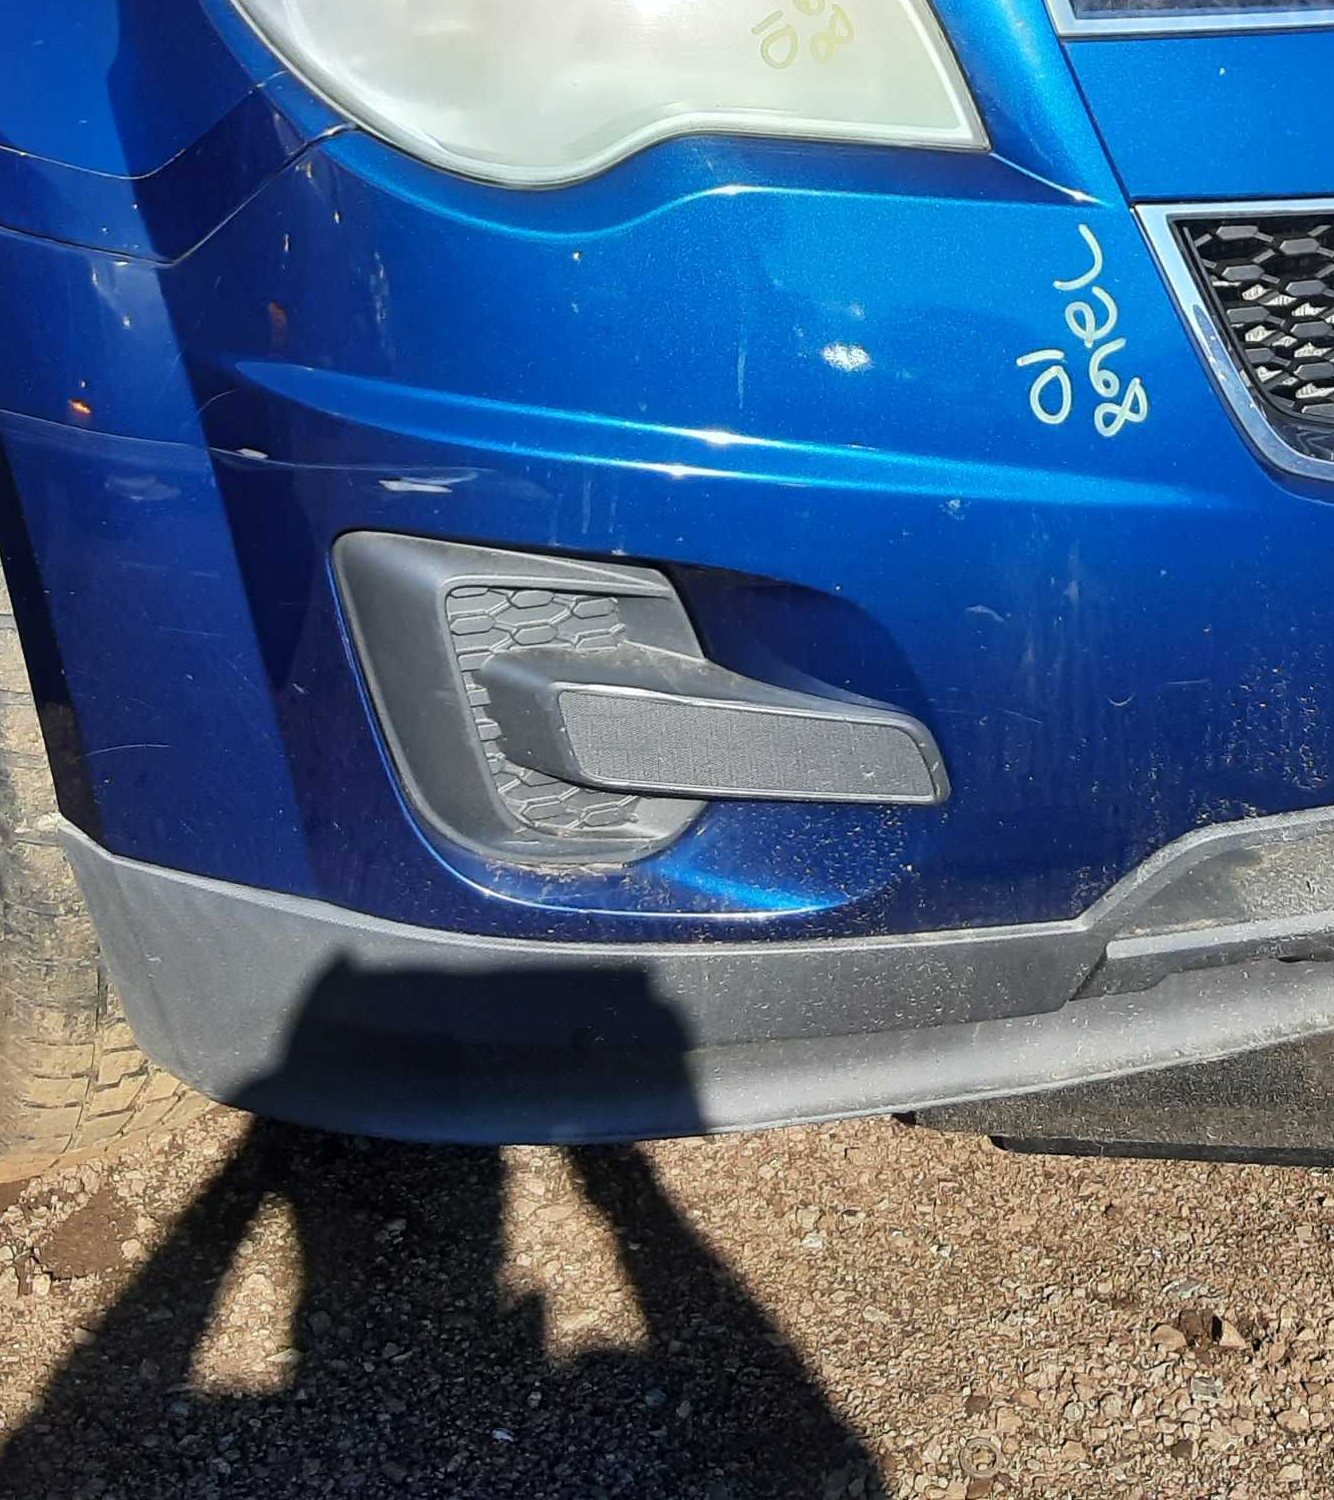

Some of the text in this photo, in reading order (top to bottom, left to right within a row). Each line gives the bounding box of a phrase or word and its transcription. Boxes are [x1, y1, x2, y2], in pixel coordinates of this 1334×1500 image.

[751, 10, 799, 70] 10
[1053, 223, 1149, 437] 7268
[1016, 349, 1072, 425] 10
